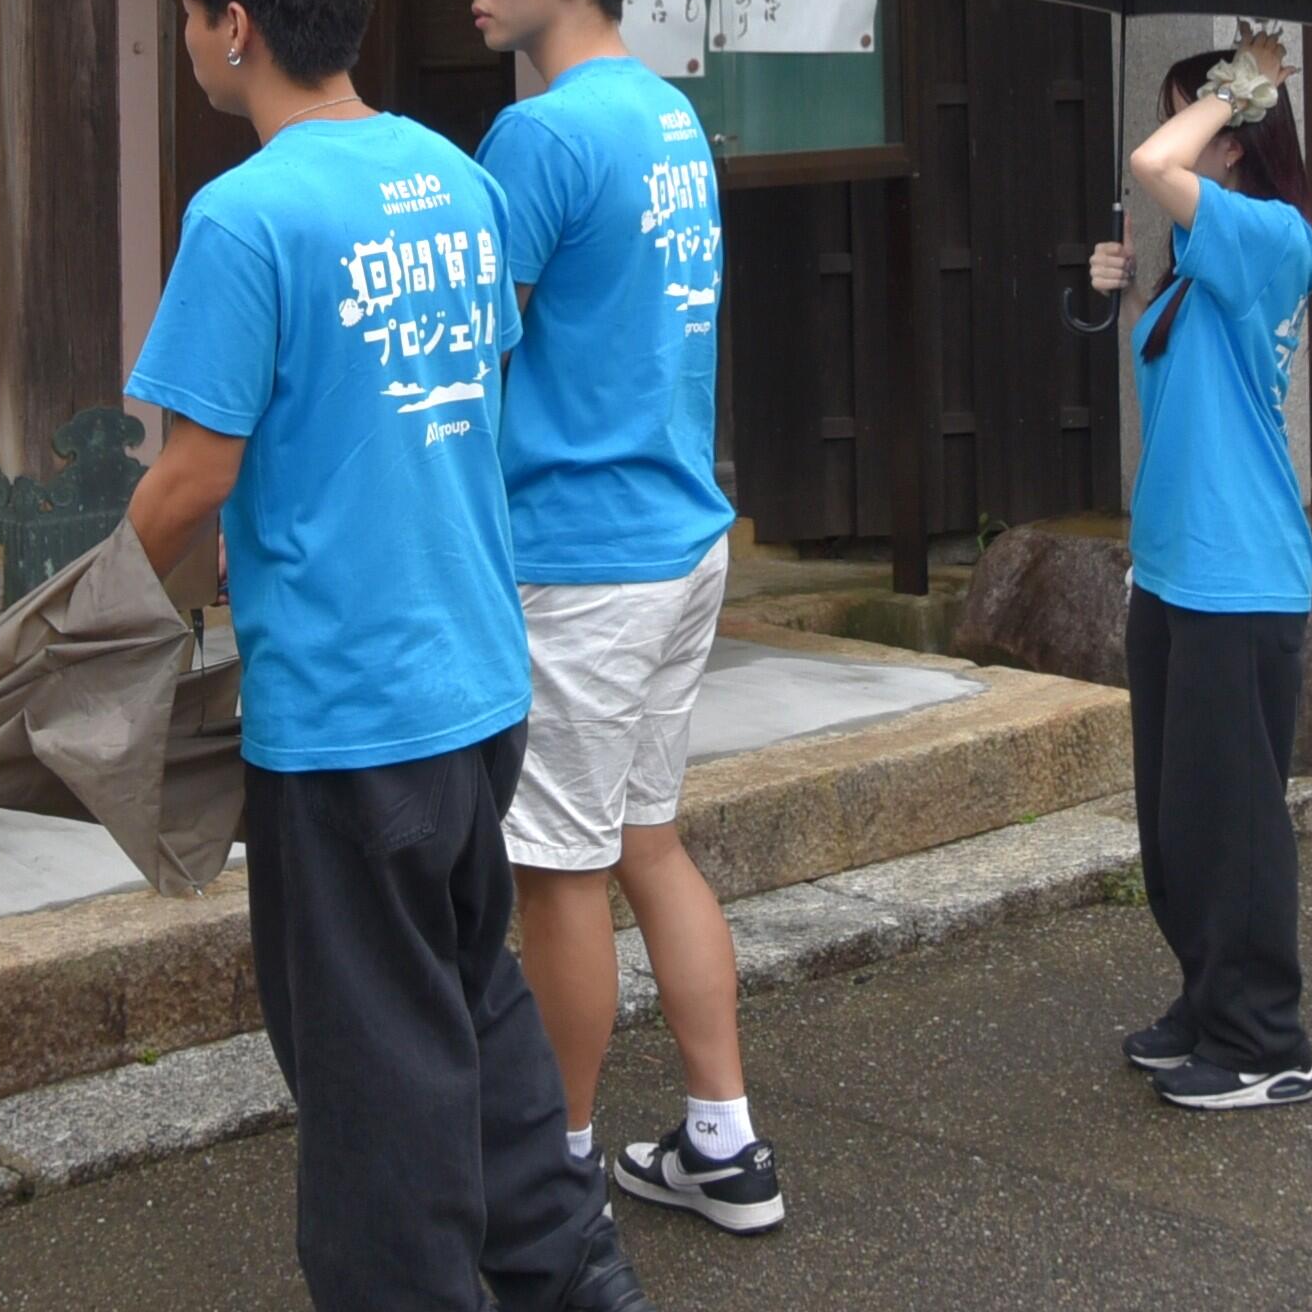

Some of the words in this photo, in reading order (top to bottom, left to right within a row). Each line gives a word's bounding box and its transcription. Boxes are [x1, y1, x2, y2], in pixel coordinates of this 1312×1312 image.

[379, 173, 441, 200] MEIJO
[382, 192, 452, 215] UNIVERSITY
[695, 1120, 719, 1136] CK
